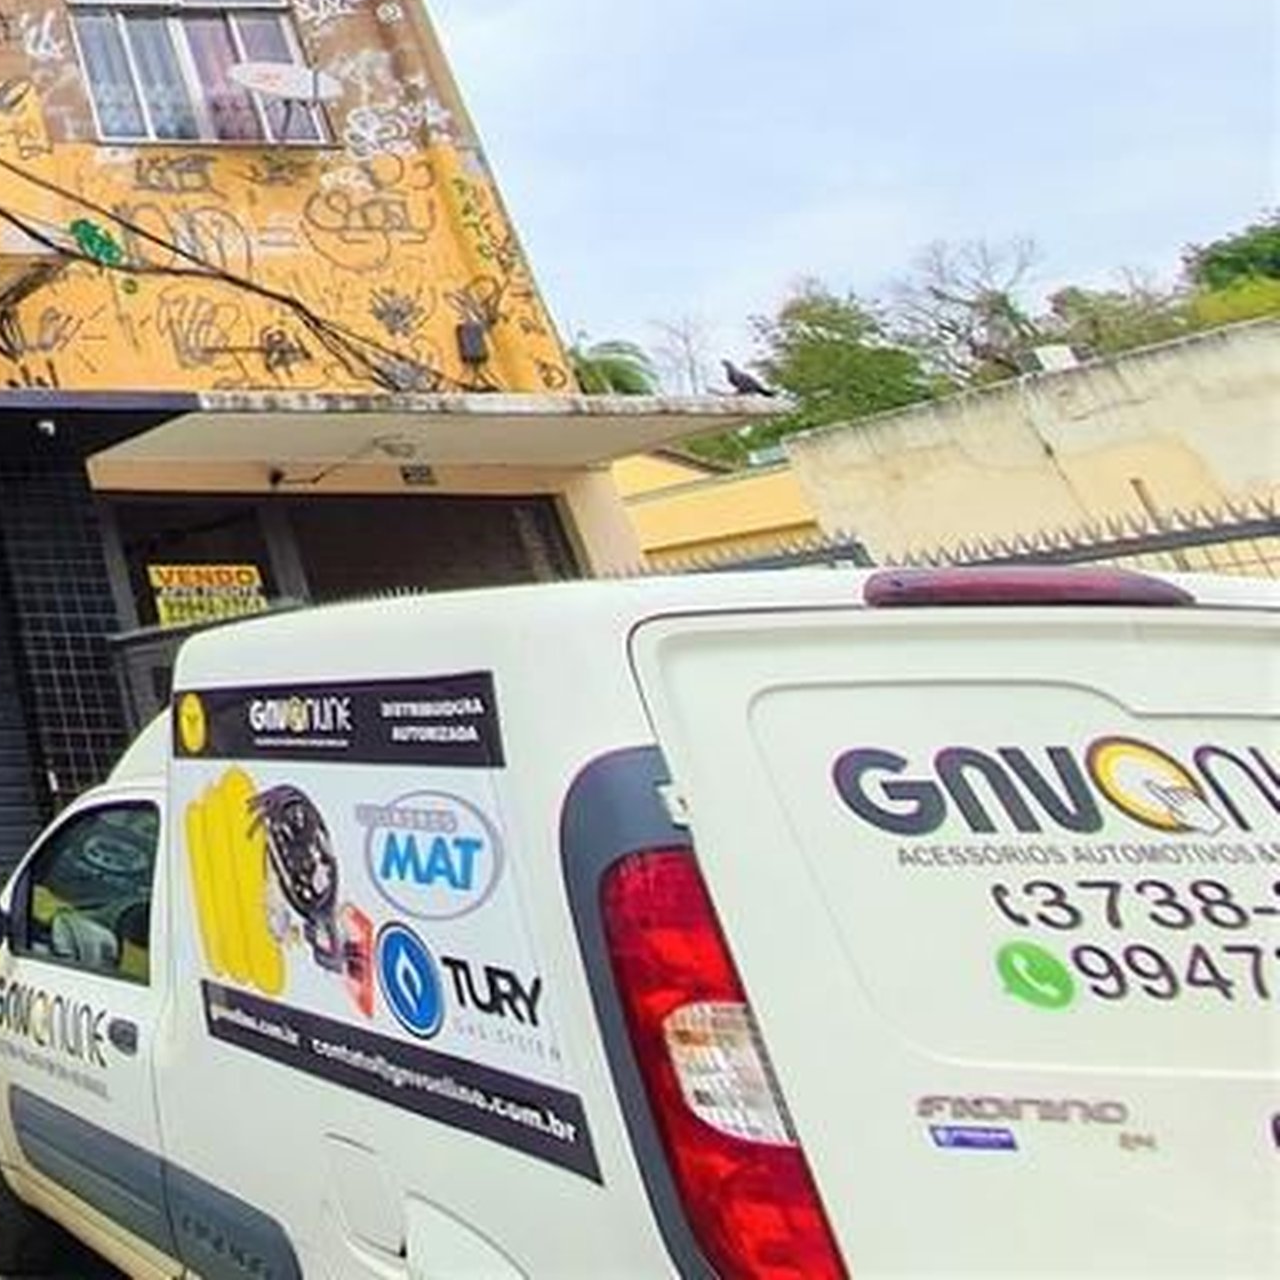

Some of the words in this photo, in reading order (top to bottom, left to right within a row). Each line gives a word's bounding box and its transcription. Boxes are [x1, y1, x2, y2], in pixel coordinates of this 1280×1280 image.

[159, 567, 256, 587] VENDO
[380, 832, 483, 891] MAT
[1072, 843, 1253, 865] AUTOMOTIVOS
[1023, 880, 1280, 930] 3738-
[441, 955, 542, 1028] TURY
[1071, 942, 1280, 1001] 9947
